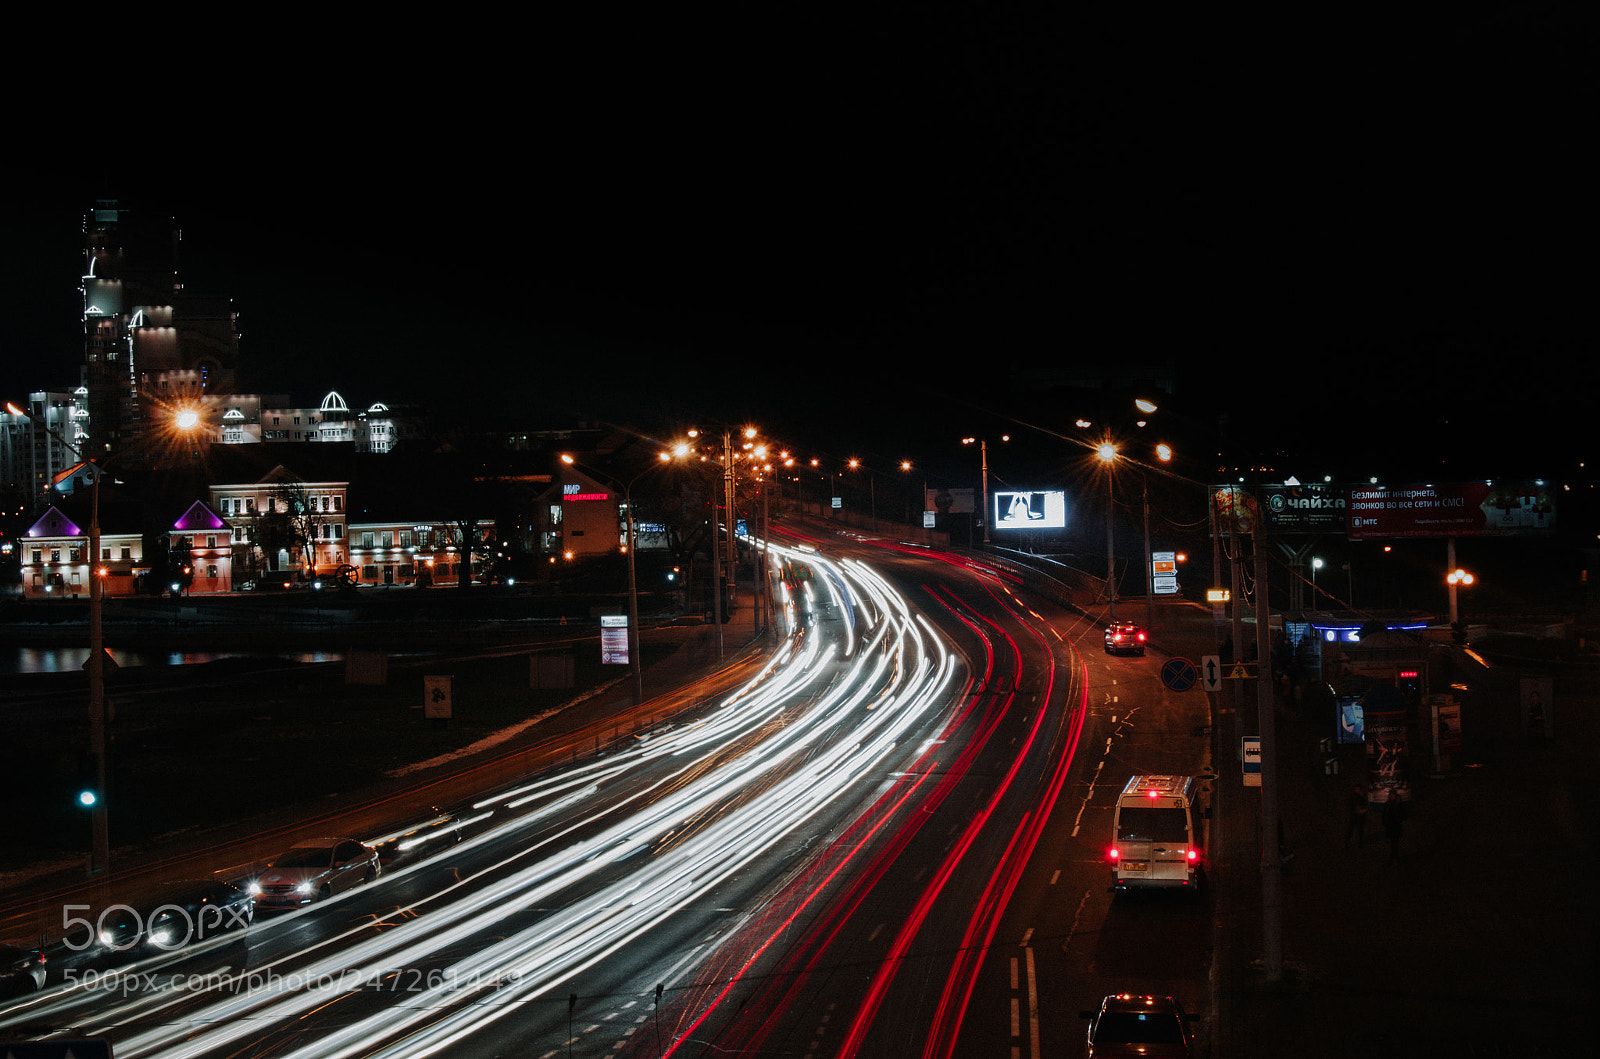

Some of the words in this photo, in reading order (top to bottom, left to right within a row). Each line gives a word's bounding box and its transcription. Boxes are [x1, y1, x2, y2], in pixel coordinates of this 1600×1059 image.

[563, 484, 581, 495] МИР
[1351, 490, 1390, 499] Безлимит
[1392, 489, 1438, 499] интернета,
[1351, 501, 1385, 510] звонков
[1386, 501, 1397, 509] во
[1398, 500, 1412, 508] все
[1414, 500, 1432, 508] сети
[1442, 497, 1465, 507] СМС!
